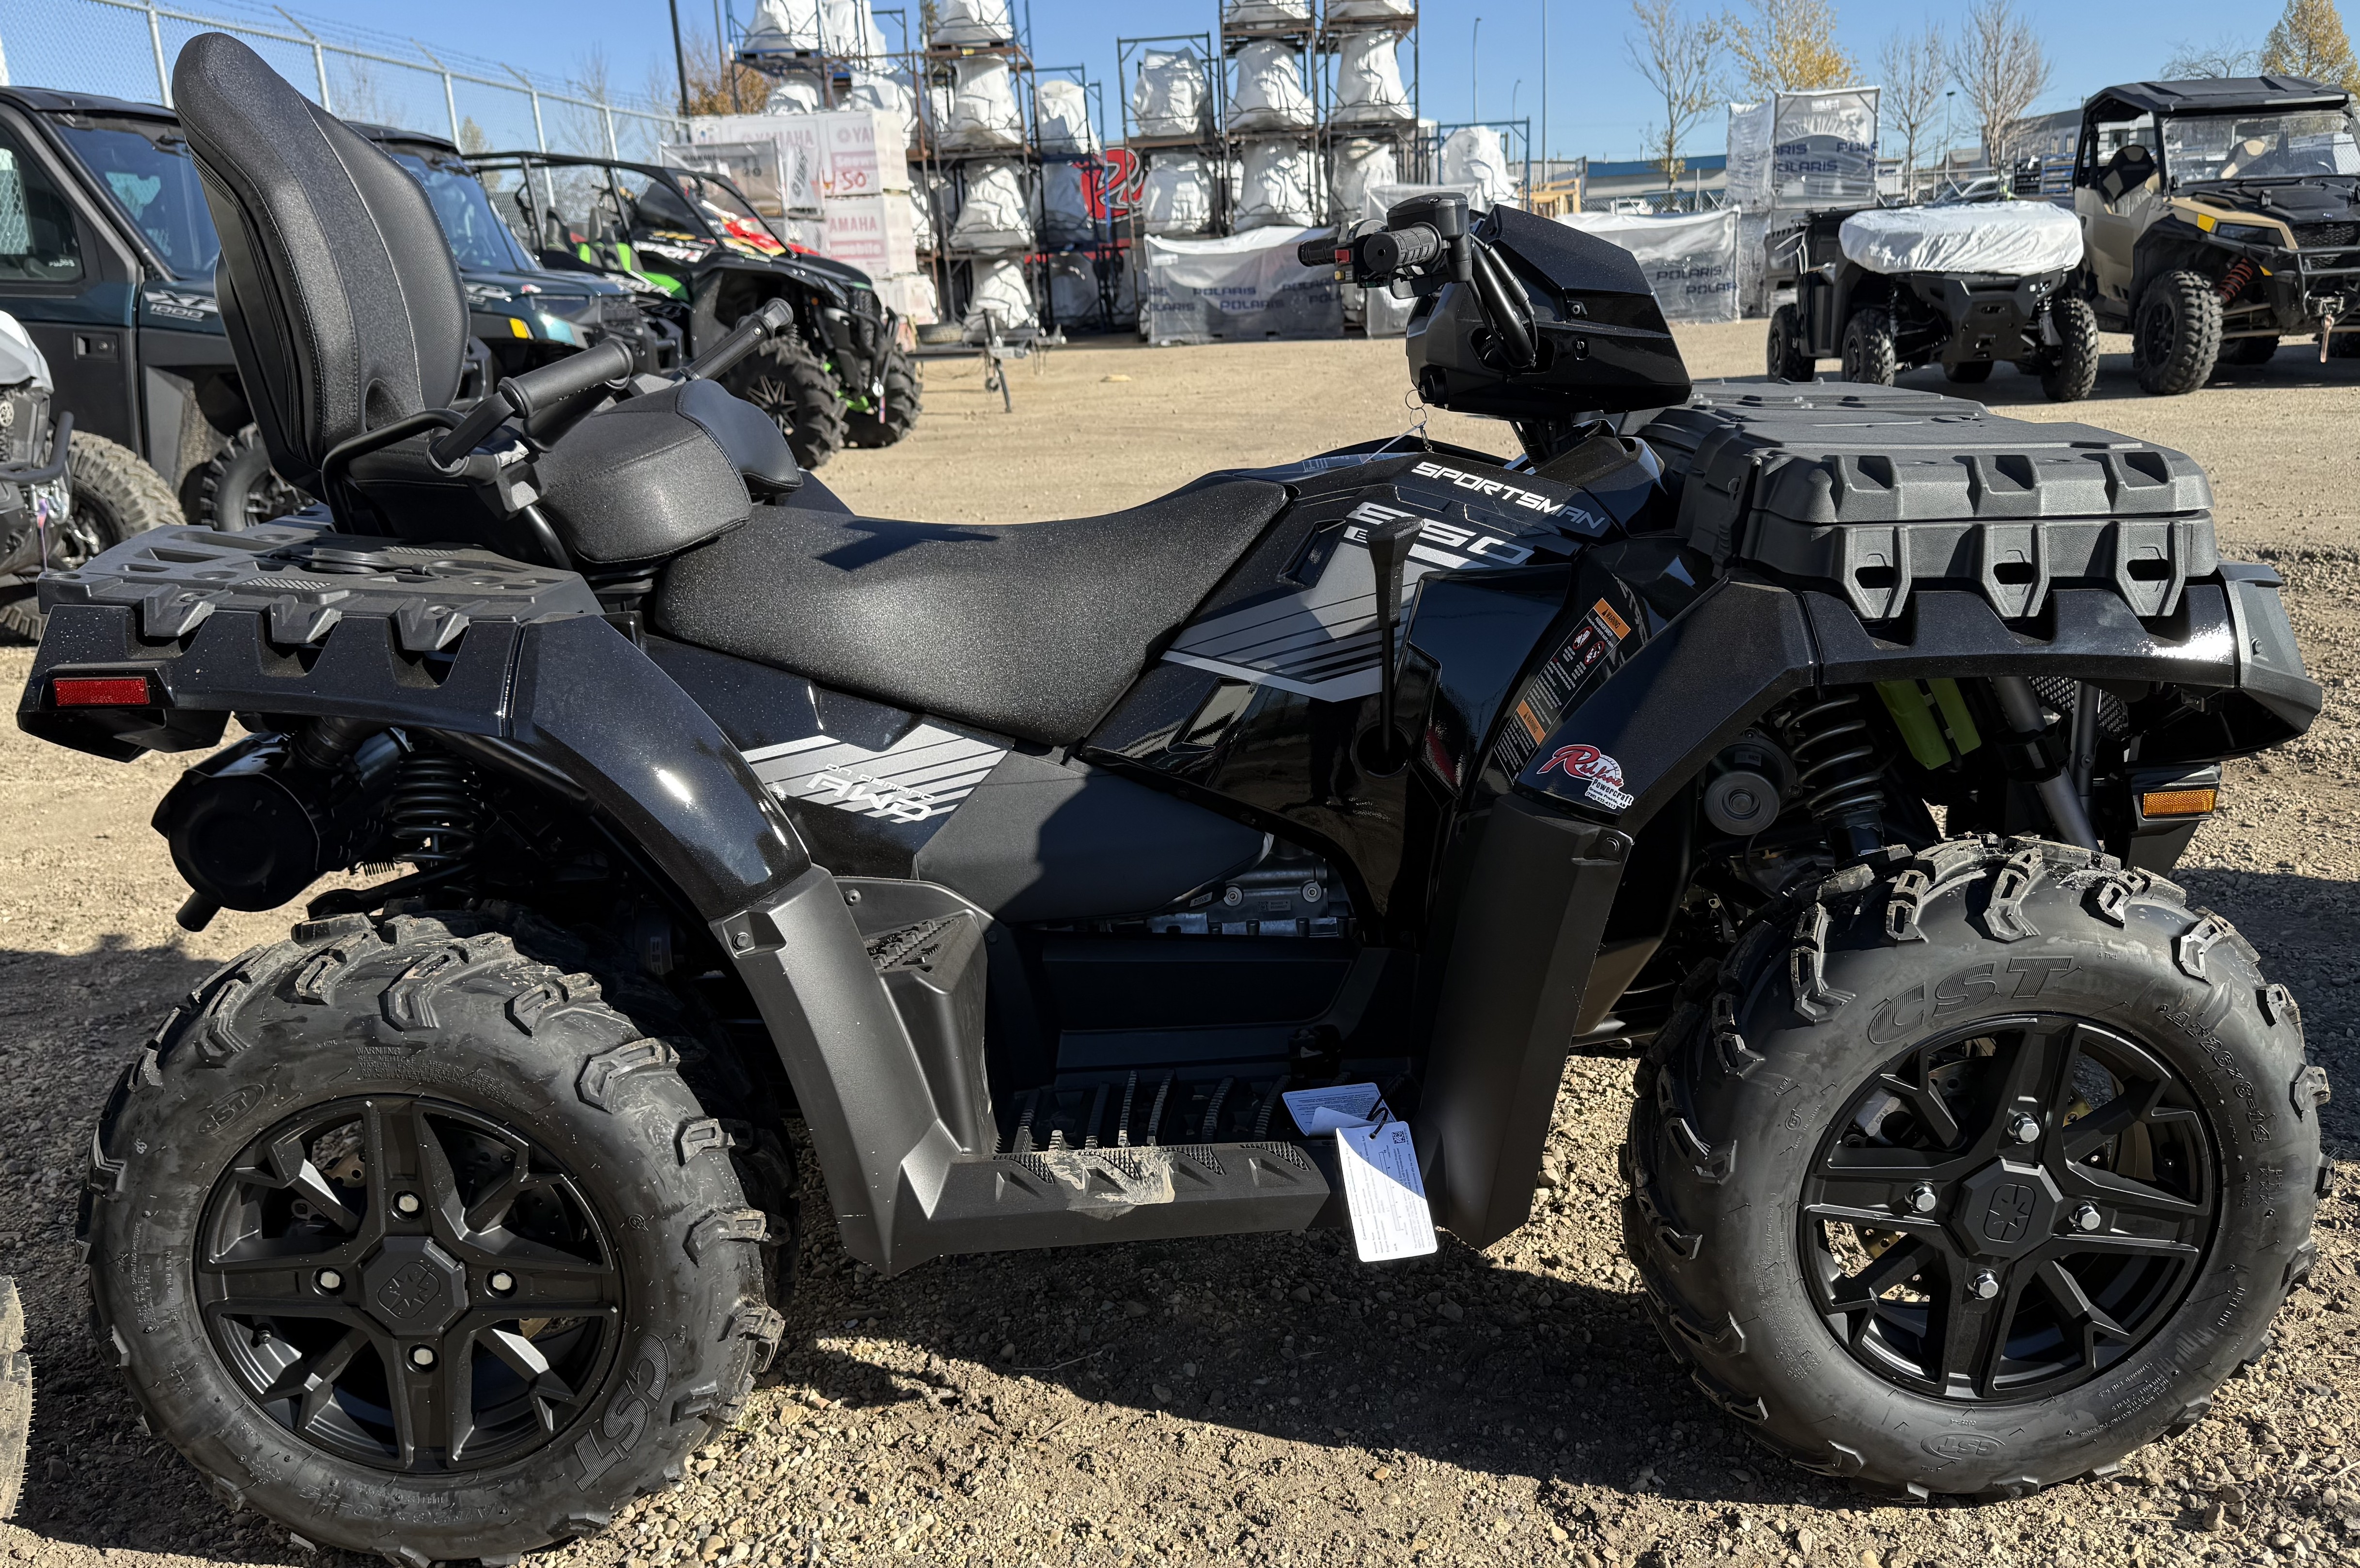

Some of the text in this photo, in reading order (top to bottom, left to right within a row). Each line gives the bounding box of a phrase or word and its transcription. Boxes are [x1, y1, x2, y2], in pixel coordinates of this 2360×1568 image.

[1774, 160, 1838, 172] OLARIS
[828, 217, 878, 233] AMAHA
[1656, 265, 1722, 281] POLARIS
[1193, 286, 1256, 297] POLARIS
[1219, 300, 1284, 311] POLARIS
[1411, 461, 1606, 530] SPORTSMAN
[1606, 612, 1621, 629] WARNING
[859, 773, 935, 802] DEMAND
[1591, 779, 1633, 805] Powercraft
[806, 772, 932, 821] AWD
[1867, 956, 2074, 1045] CST
[355, 1046, 401, 1055] WARNING
[421, 1059, 448, 1070] LABEL
[131, 1221, 142, 1251] PRESSURE
[574, 1333, 670, 1493] CST
